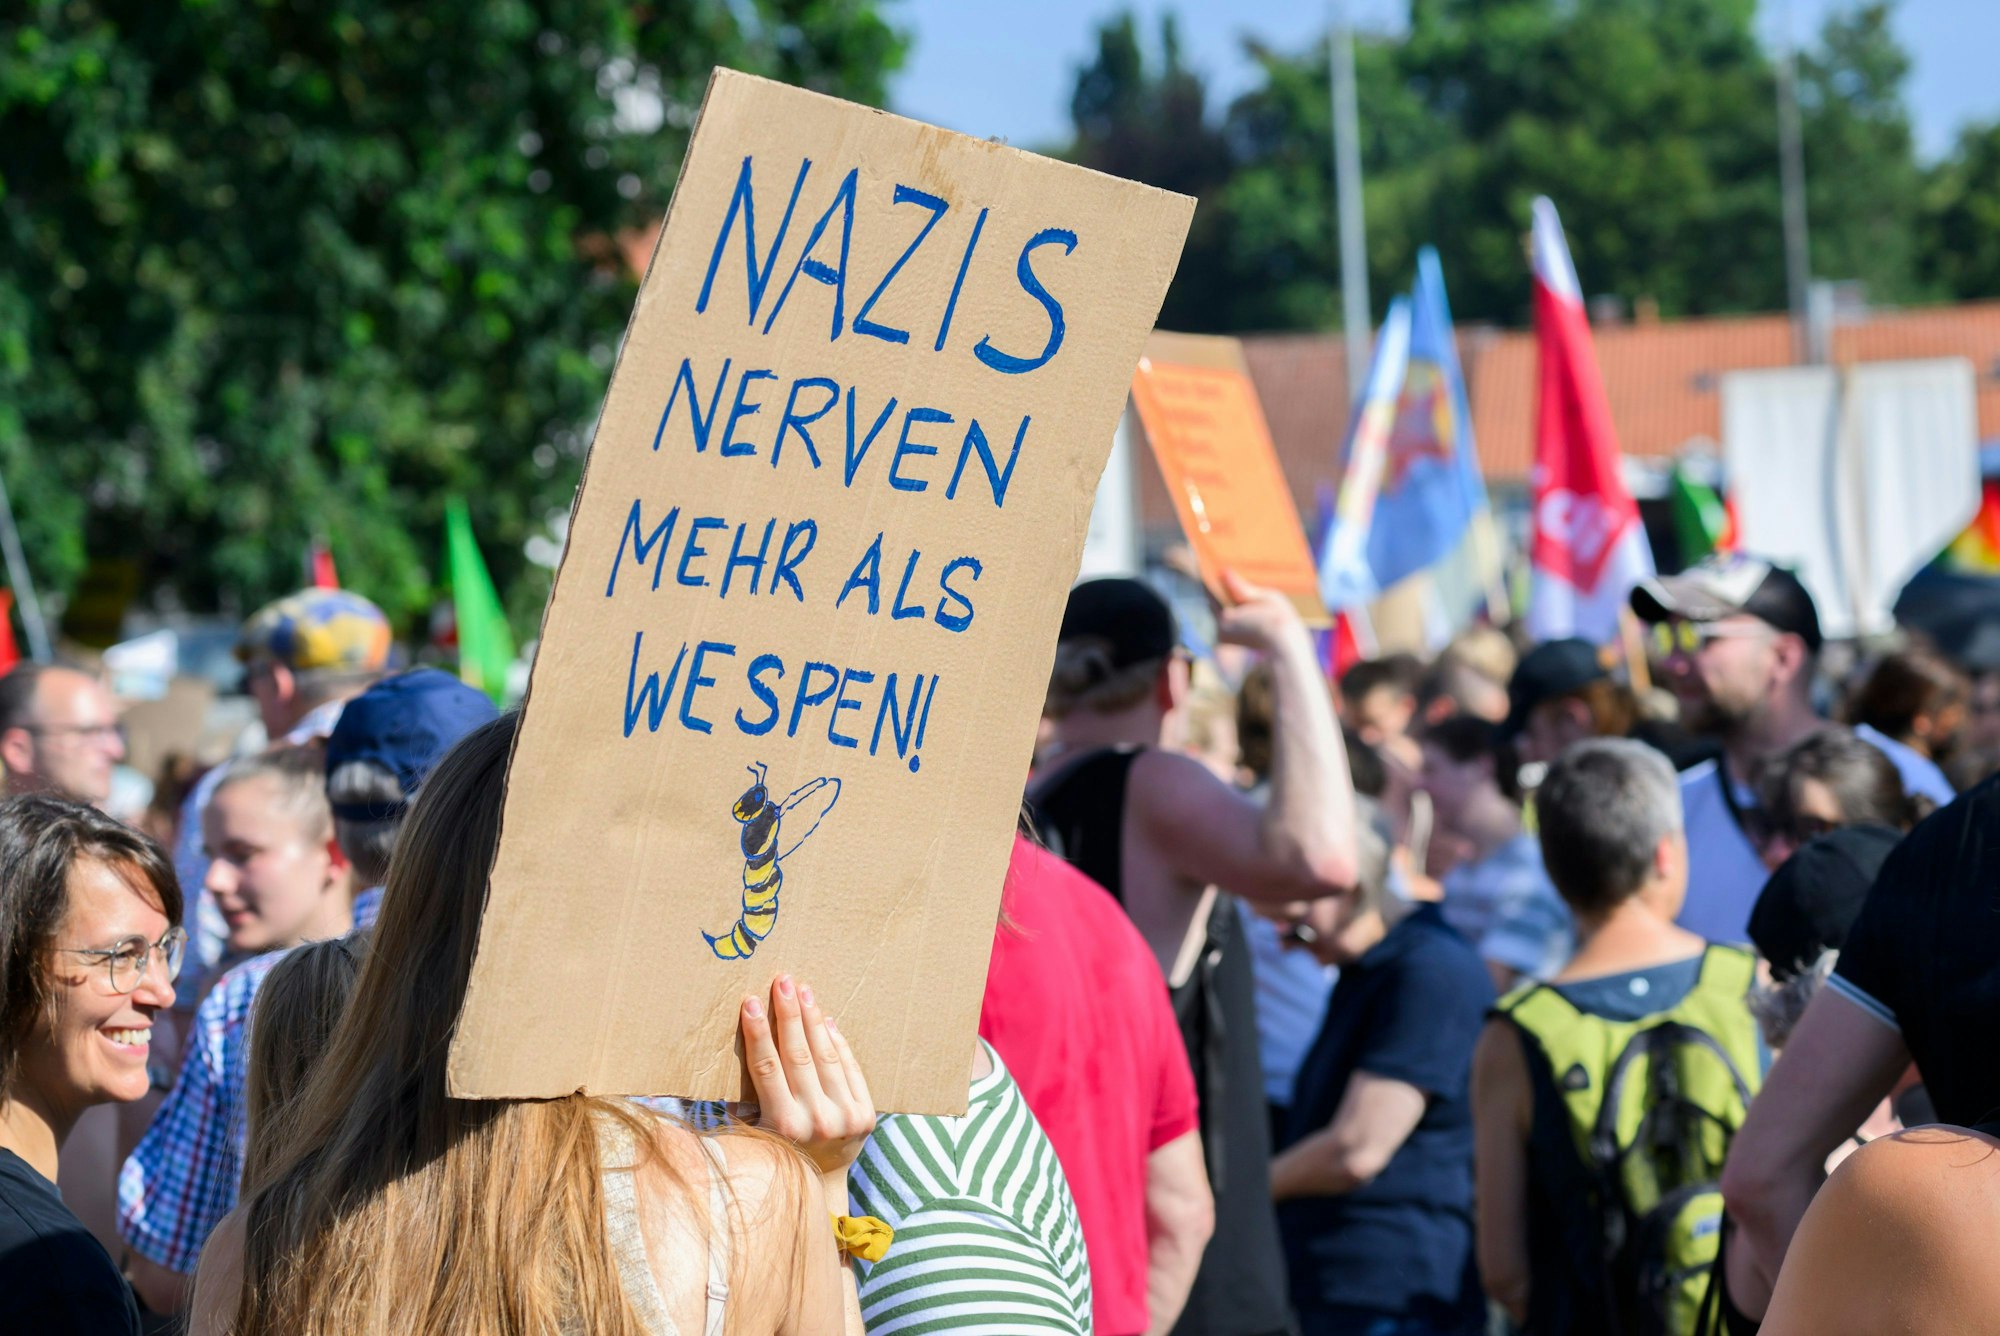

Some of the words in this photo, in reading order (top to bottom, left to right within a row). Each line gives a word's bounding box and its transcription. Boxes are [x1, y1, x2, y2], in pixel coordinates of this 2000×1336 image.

[695, 155, 1079, 375] NAZIS
[653, 357, 1032, 508] NERVEN
[605, 499, 819, 603] MEHR
[835, 531, 983, 634] ALS
[623, 631, 940, 772] WESPEN!
